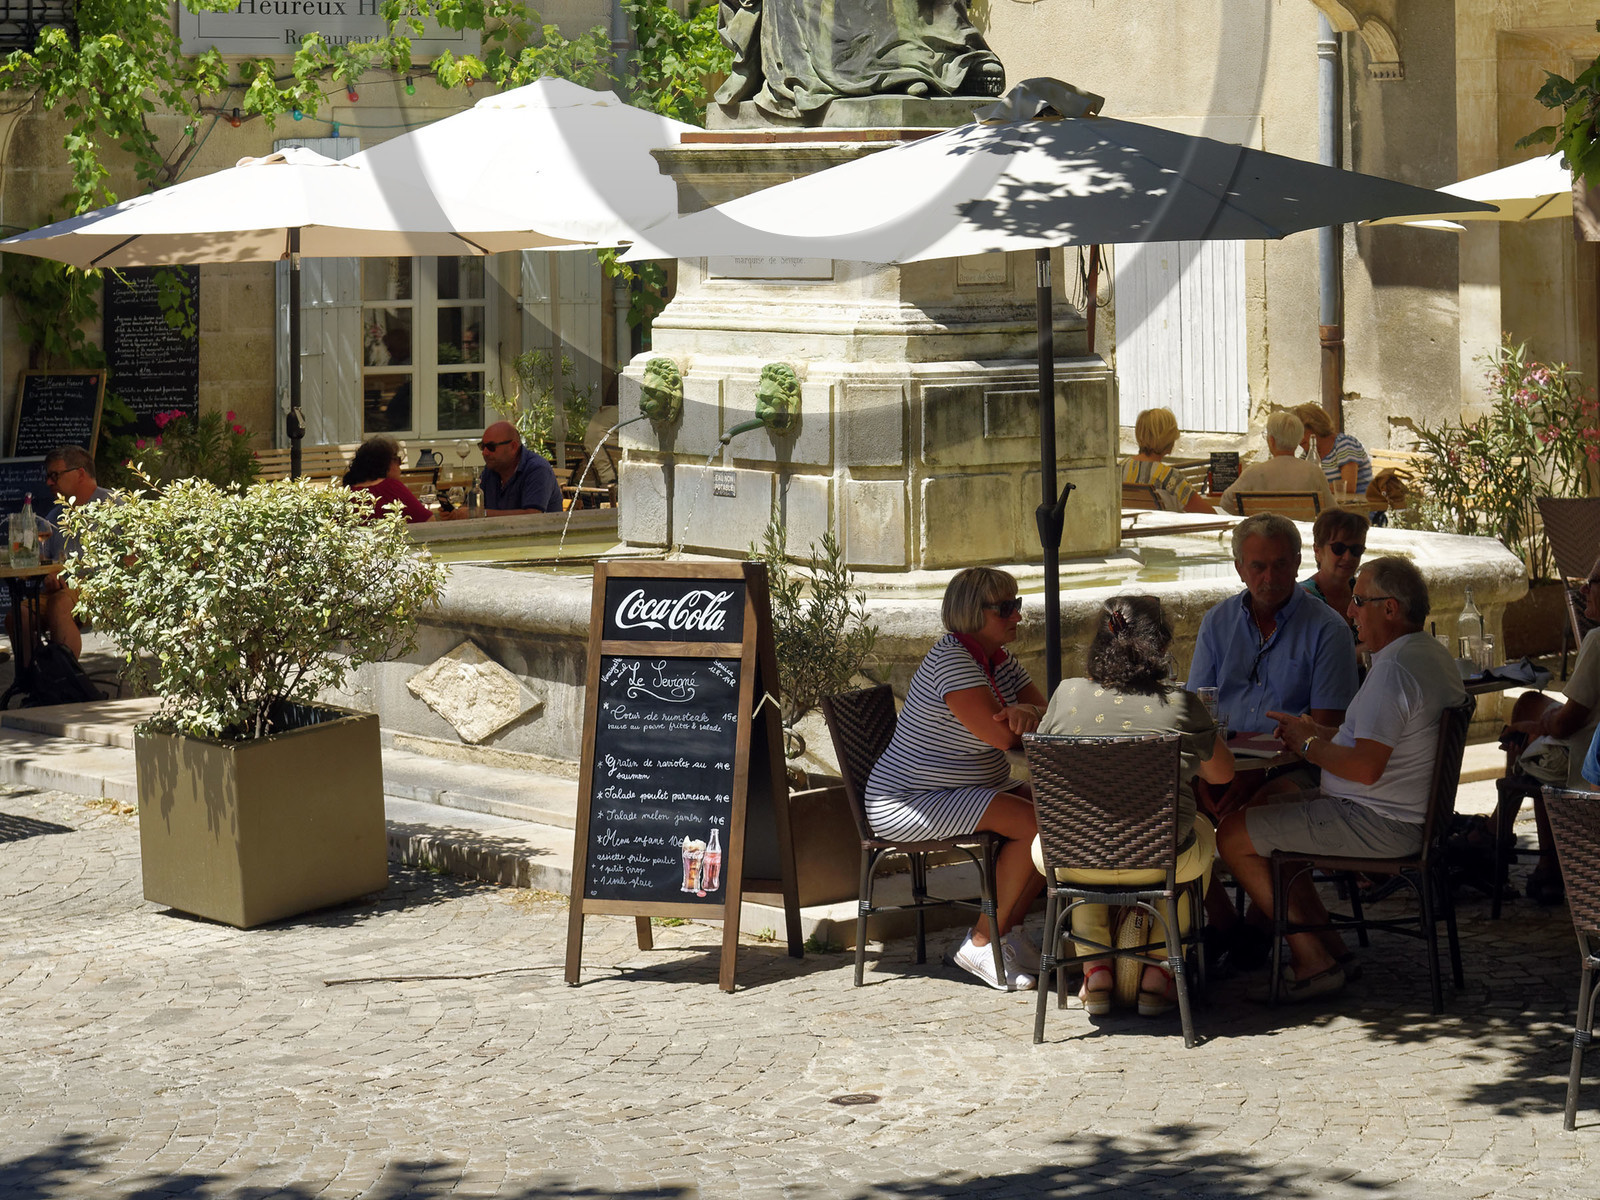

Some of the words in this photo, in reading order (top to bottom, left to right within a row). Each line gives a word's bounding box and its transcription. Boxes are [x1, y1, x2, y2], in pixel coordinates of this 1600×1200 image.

[615, 588, 735, 631] Coca-Cola
[628, 661, 646, 687] Le
[643, 711, 659, 721] de
[604, 753, 639, 777] Gratin
[643, 758, 653, 768] de
[691, 761, 708, 769] au
[604, 785, 636, 800] Salade
[640, 788, 669, 803] poulet
[671, 791, 712, 803] parmesan
[606, 809, 638, 821] Salade
[633, 835, 665, 847] enfant
